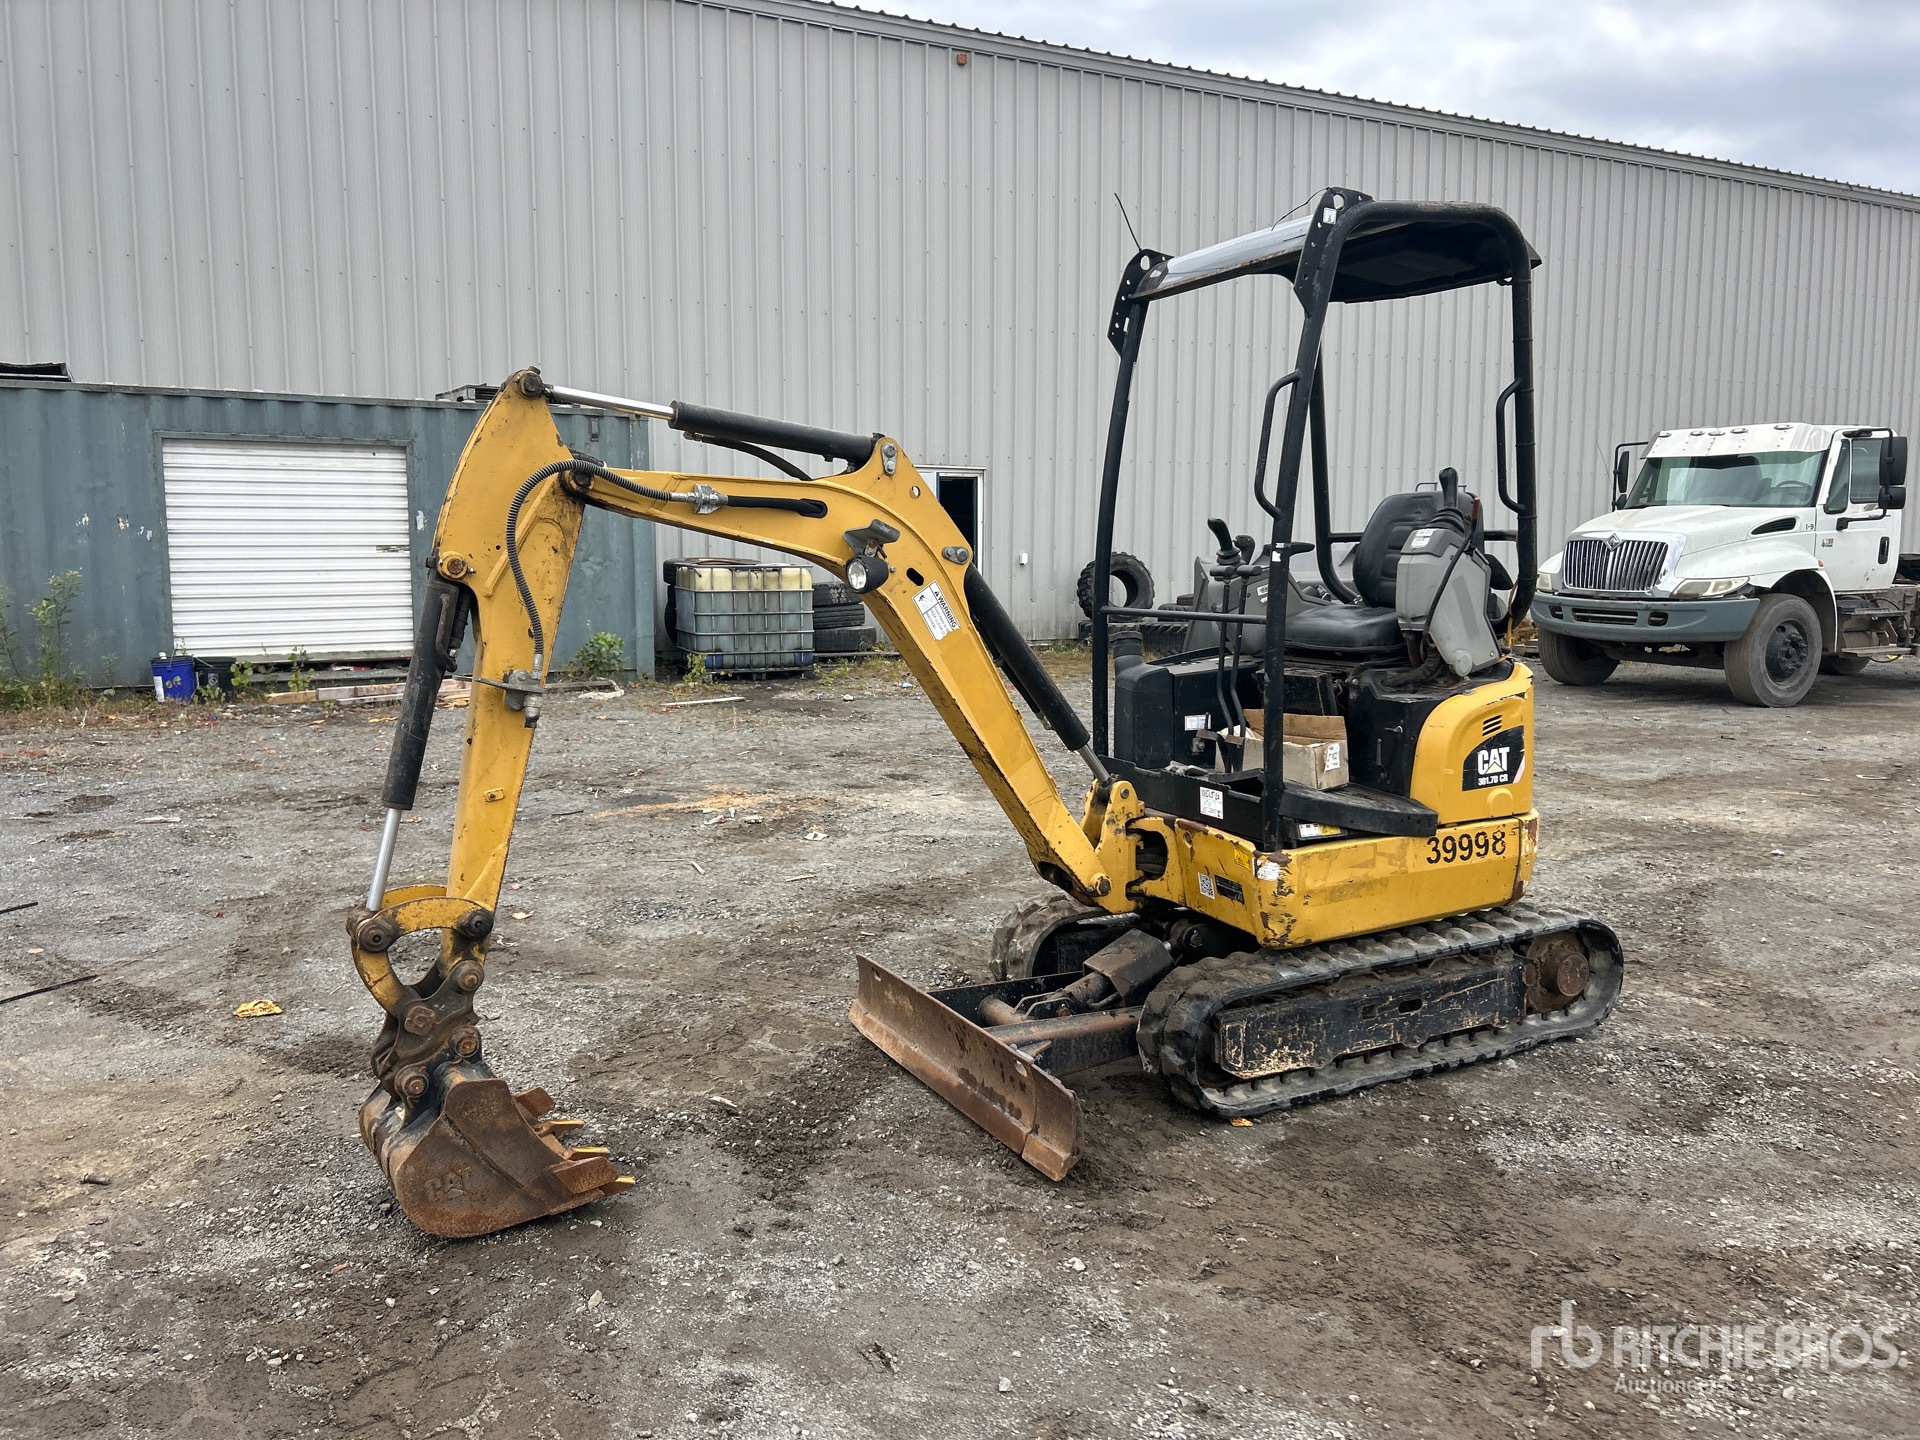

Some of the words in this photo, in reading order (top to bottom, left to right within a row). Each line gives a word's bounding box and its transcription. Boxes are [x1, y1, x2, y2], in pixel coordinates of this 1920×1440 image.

[938, 596, 957, 628] WARNING
[1477, 747, 1510, 776] CAT
[1478, 775, 1498, 786] 301.7D
[1499, 773, 1509, 782] CR
[1426, 829, 1506, 864] 39998
